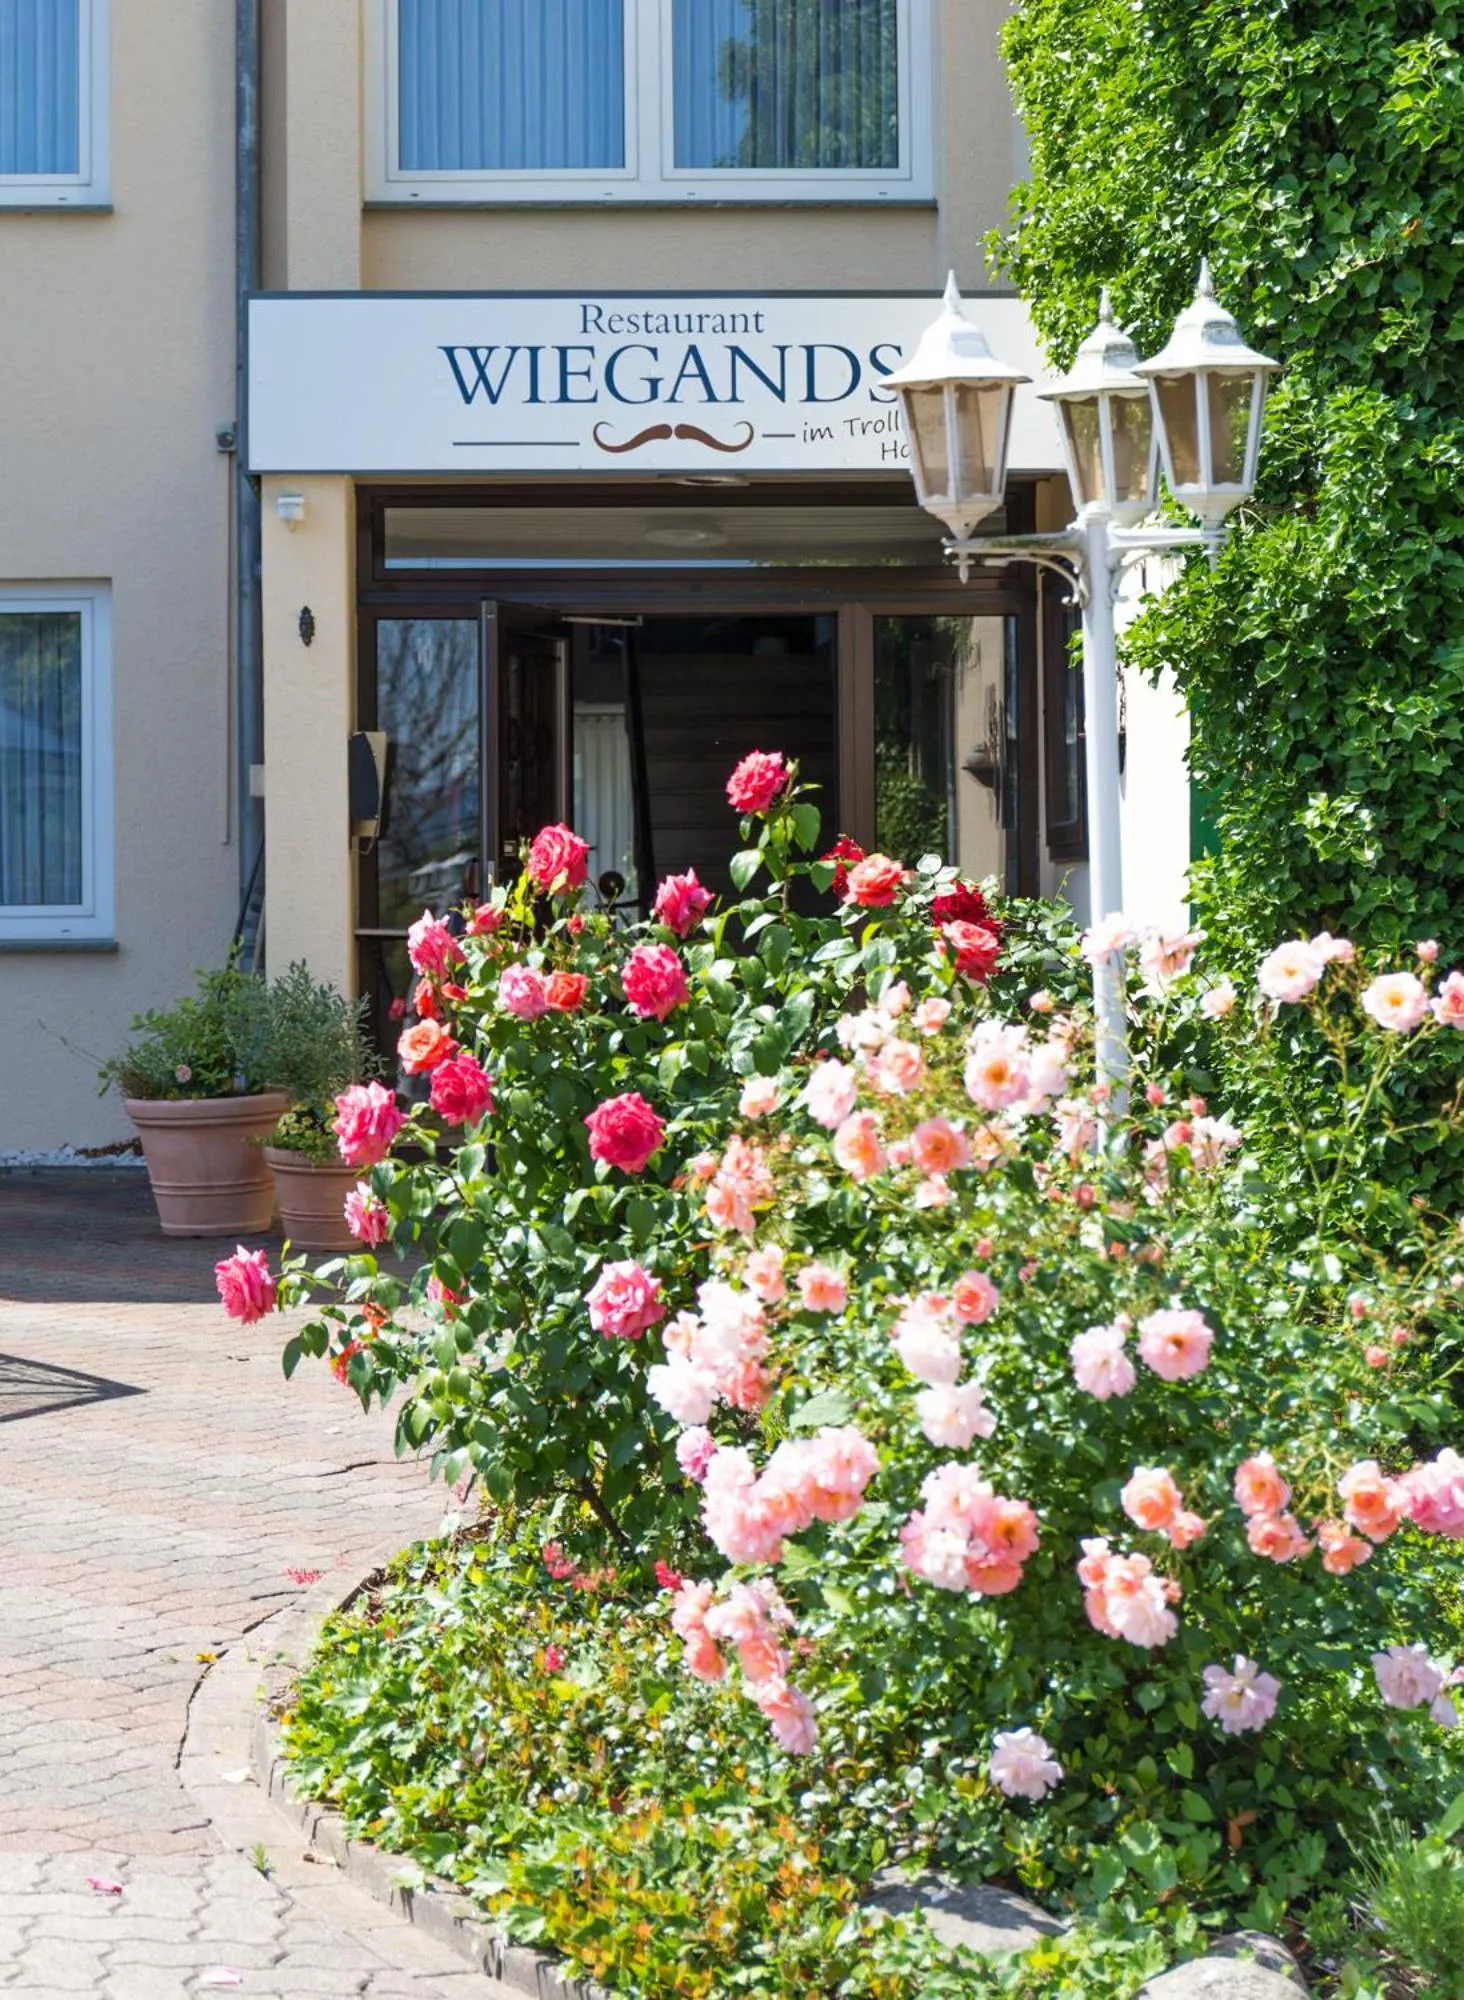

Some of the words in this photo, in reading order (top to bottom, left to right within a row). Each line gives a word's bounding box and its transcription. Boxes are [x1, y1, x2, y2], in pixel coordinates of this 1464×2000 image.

[579, 303, 765, 335] Restaurant
[437, 343, 903, 404] WIEGANDS
[802, 421, 835, 443] im
[842, 409, 900, 437] Troll
